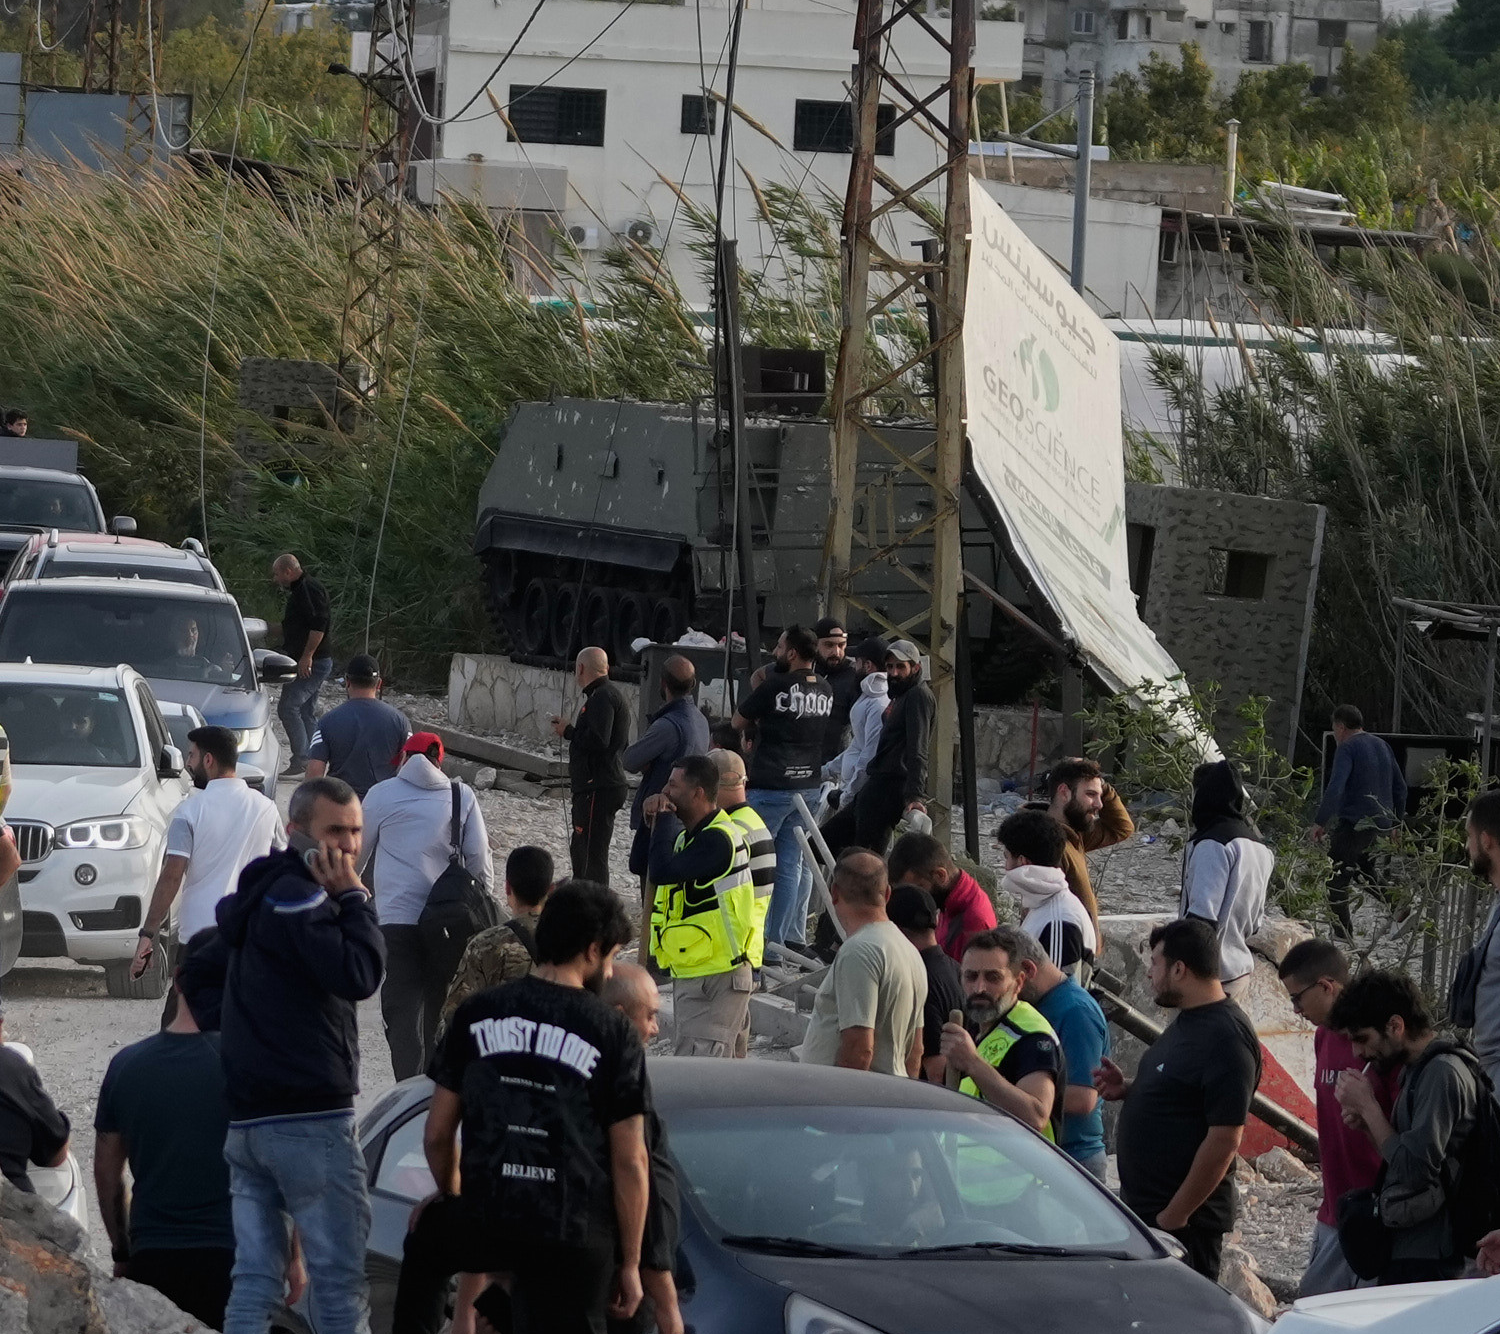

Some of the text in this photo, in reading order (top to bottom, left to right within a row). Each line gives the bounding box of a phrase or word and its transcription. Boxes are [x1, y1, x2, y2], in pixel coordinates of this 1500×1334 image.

[983, 364, 1101, 506] GEOSCIENCE
[469, 1016, 602, 1081] TRUST NO ONE
[501, 1162, 556, 1182] BELIEVE
